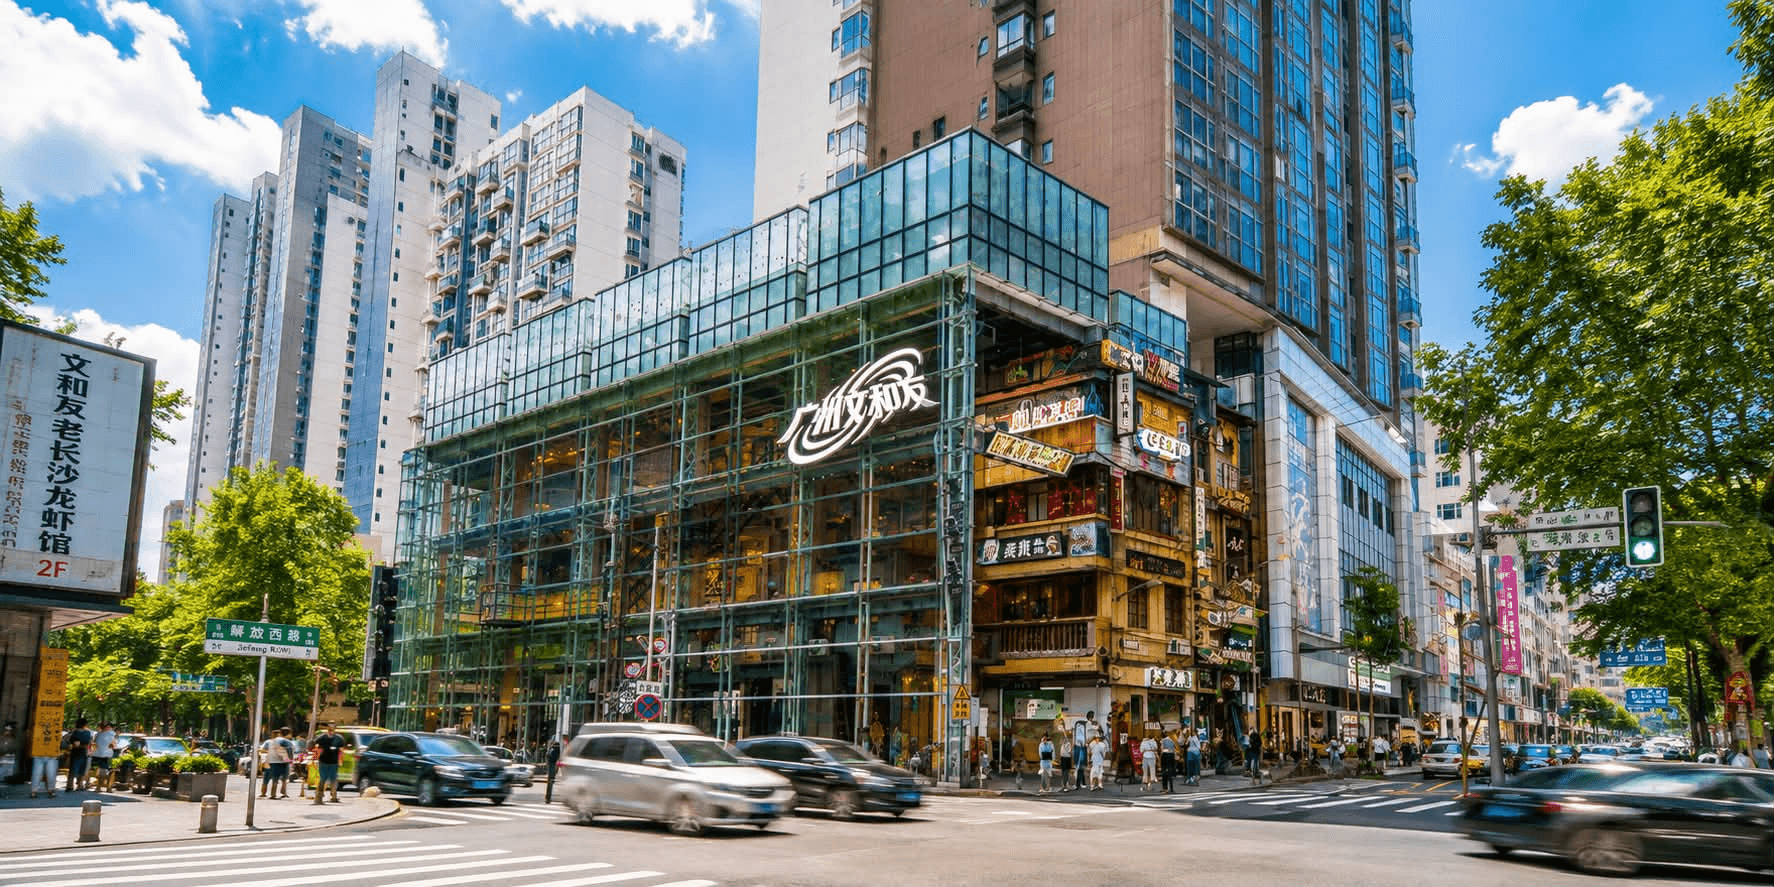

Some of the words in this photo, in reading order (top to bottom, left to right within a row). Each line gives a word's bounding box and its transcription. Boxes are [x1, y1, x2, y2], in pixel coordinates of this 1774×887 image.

[777, 375, 940, 443] 广州文和友
[38, 352, 92, 555] 文和友老长沙龙虾馆
[37, 558, 68, 578] 2F
